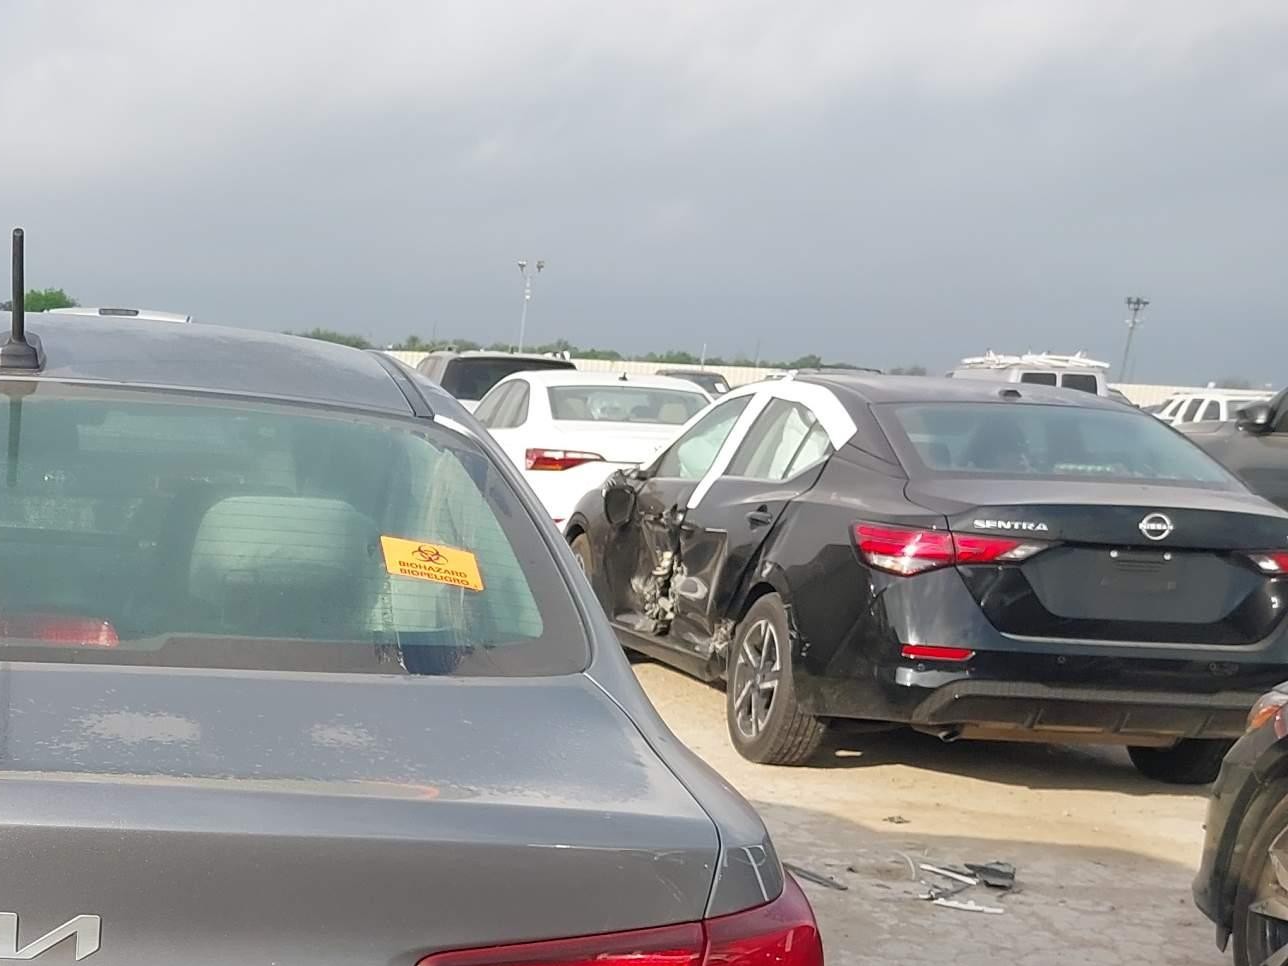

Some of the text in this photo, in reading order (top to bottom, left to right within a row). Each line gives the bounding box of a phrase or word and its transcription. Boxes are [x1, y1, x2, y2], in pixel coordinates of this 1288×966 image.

[973, 519, 1049, 532] SENTRA
[398, 560, 468, 579] BIOHAZARD
[399, 567, 470, 586] BIOPELIGRO
